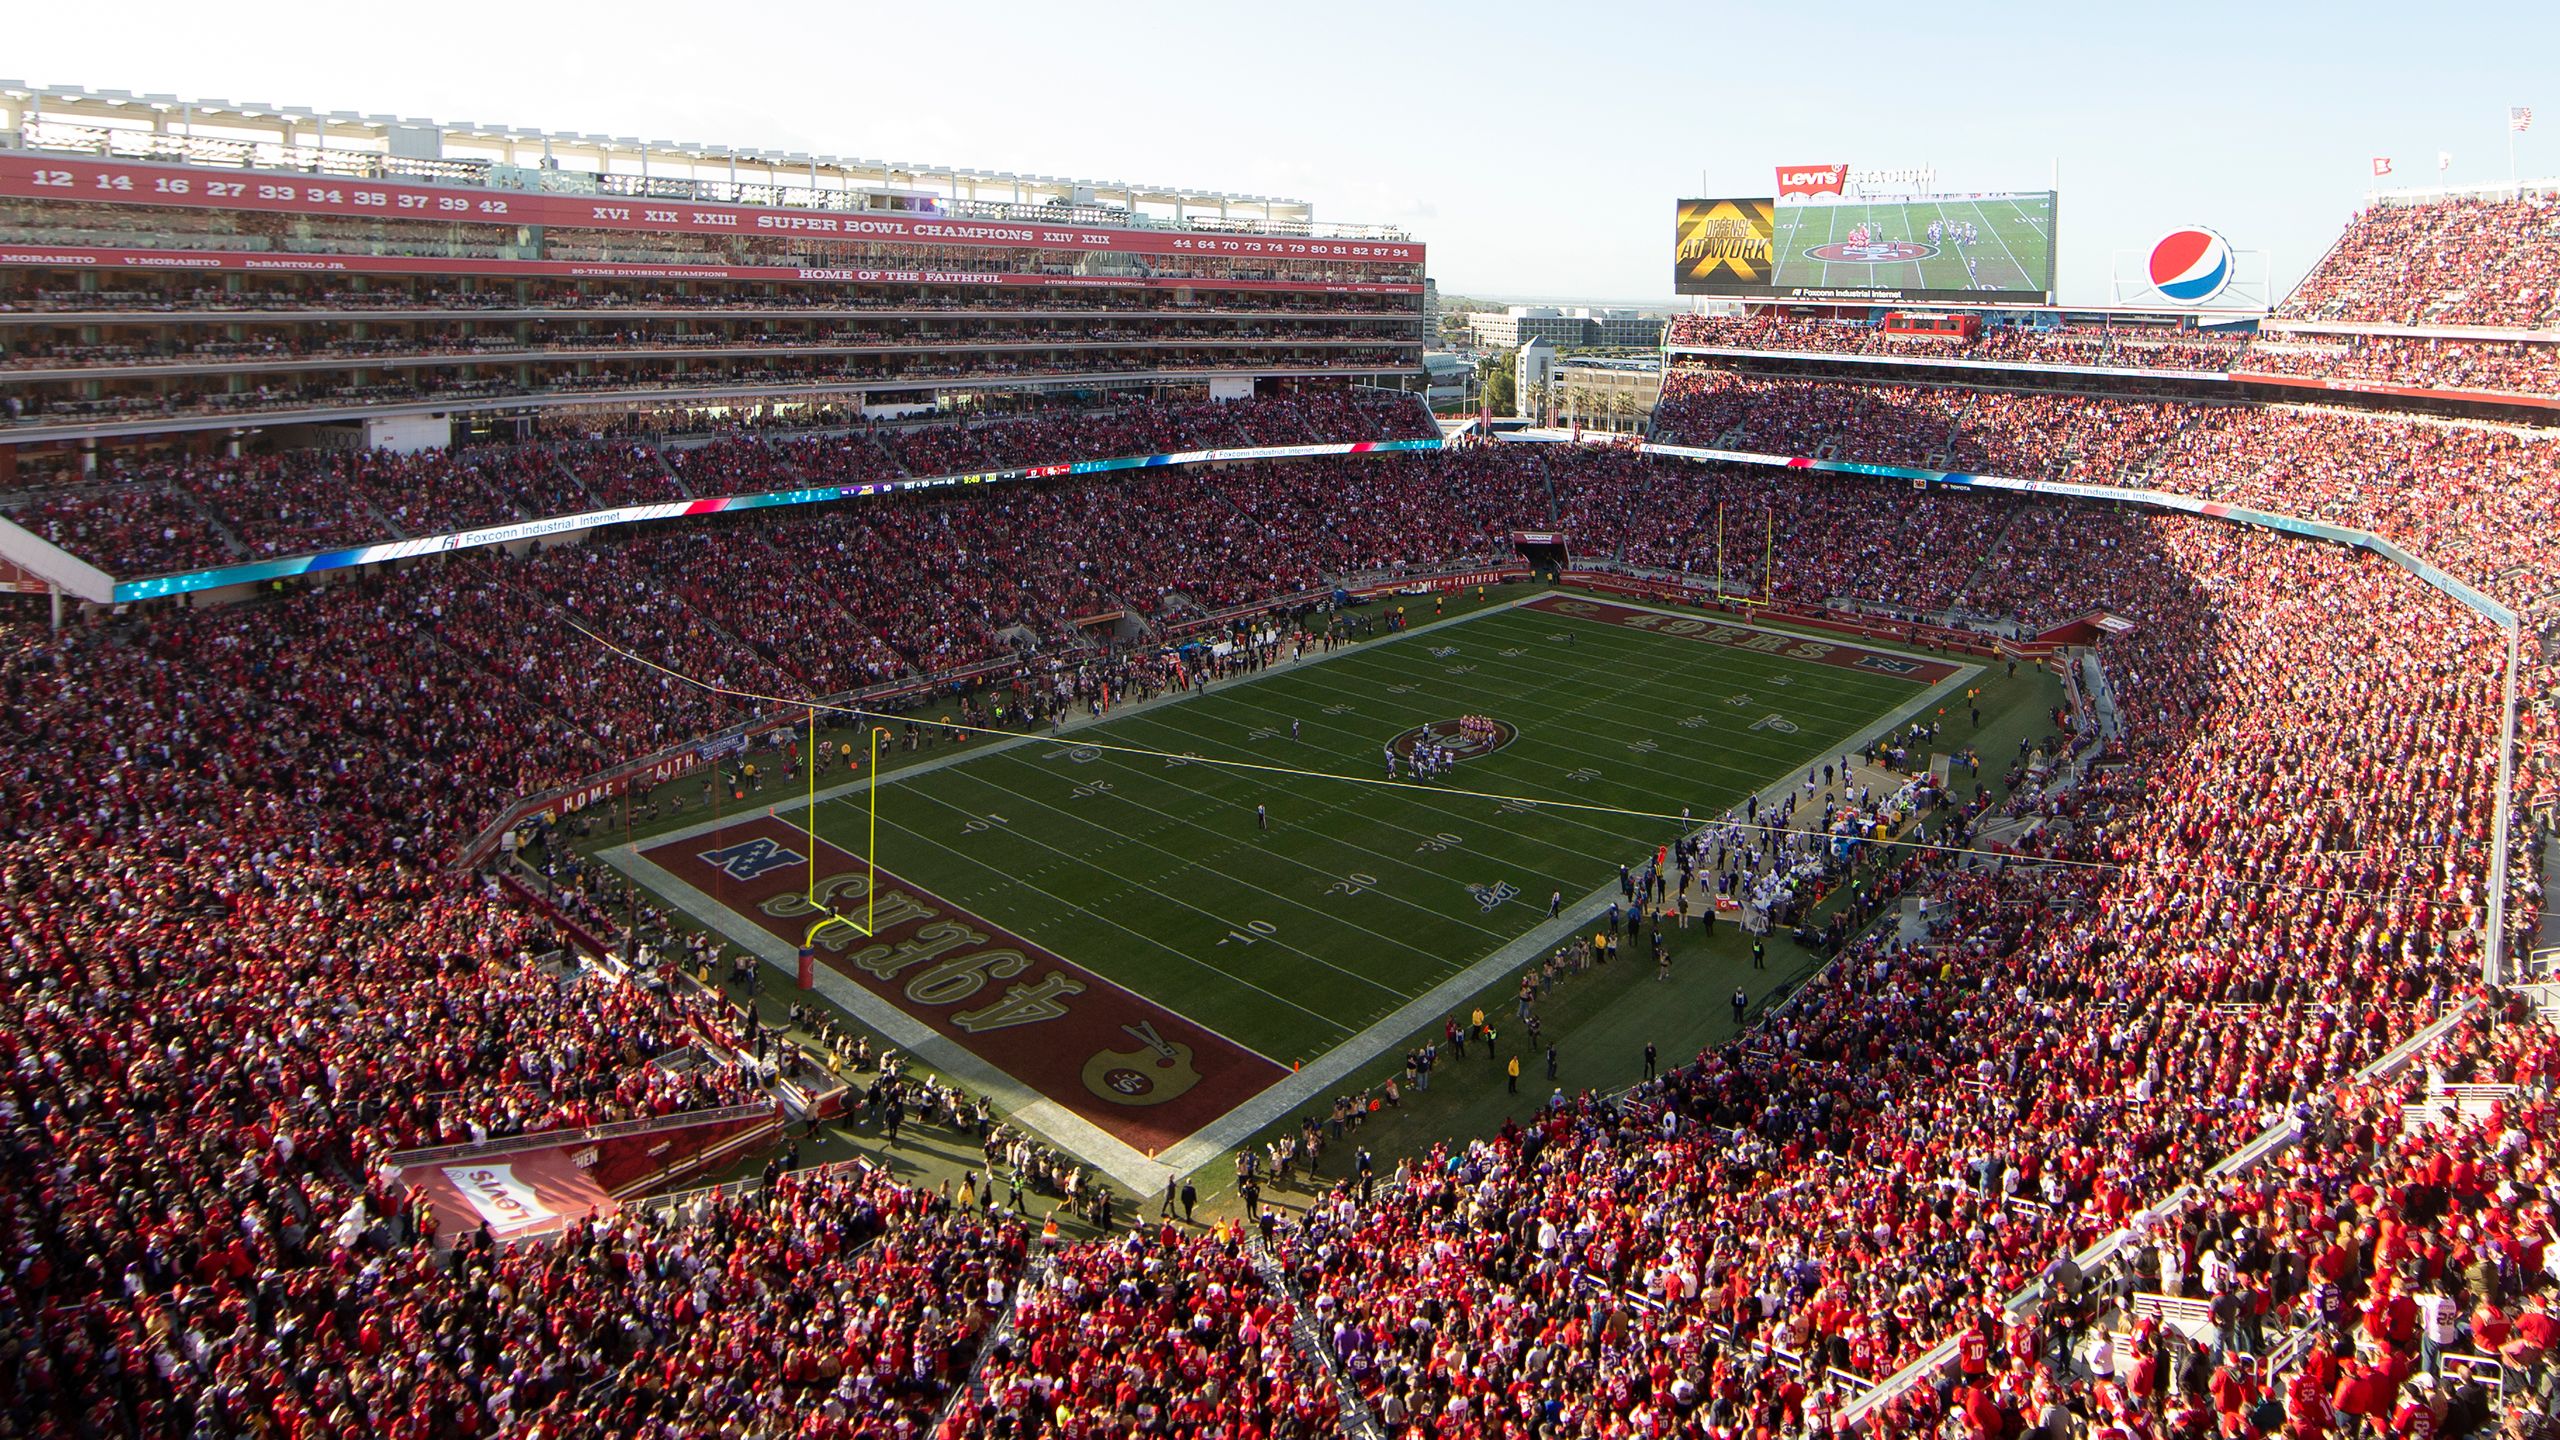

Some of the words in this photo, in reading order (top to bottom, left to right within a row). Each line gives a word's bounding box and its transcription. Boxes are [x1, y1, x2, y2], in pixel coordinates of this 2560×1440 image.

[1846, 168, 1936, 184] STADIUM
[32, 170, 73, 187] 12
[96, 174, 133, 190] 14
[155, 178, 190, 194] 16
[207, 181, 246, 197] 27
[259, 185, 295, 201] 33
[308, 188, 343, 204] 34
[354, 191, 387, 206] 35
[398, 195, 429, 209] 37
[439, 198, 470, 212] 39
[479, 200, 507, 214] 42
[593, 207, 630, 221] XVI
[644, 210, 678, 223] XIX
[693, 212, 737, 225] XXIII
[757, 215, 841, 232] SUPER
[844, 220, 908, 236] BOWL
[913, 224, 1033, 241] CHAMPIONS
[1705, 219, 1751, 237] OFFENSE
[1043, 232, 1073, 243] XXIV
[1081, 234, 1110, 244] XXIX
[1173, 238, 1192, 248] 44
[1197, 240, 1216, 249] 64
[1222, 241, 1240, 250] 70
[1244, 242, 1262, 251] 73
[1267, 243, 1284, 252] 74
[1289, 243, 1306, 253] 79
[1310, 245, 1327, 254] 80
[1333, 246, 1347, 255] 81
[1353, 246, 1369, 256] 82
[1373, 247, 1389, 256] 87
[1393, 248, 1409, 257] 94
[1681, 238, 1706, 258] AT
[1710, 238, 1771, 258] WORK
[2, 254, 96, 264] MORABITO
[141, 258, 221, 267] MORABITO
[799, 269, 852, 280] HOME
[858, 271, 881, 281] OF
[885, 271, 919, 282] THE
[925, 272, 1003, 283] FAITHFUL
[1803, 289, 1834, 297] Foxconn
[1836, 289, 1870, 298] Industrial
[1220, 450, 1250, 458] Foxconn
[1289, 447, 1315, 455] Internet
[963, 475, 980, 484] 9:49
[2041, 483, 2081, 494] Foxconn
[2084, 487, 2128, 499] Industrial
[2133, 491, 2164, 503] Internet
[466, 530, 517, 545] Foxconn
[522, 518, 574, 536] Industrial
[580, 512, 620, 526] Internet
[1455, 573, 1499, 586] FAITHFUL
[1425, 832, 1463, 853] 30
[1332, 872, 1378, 897] 20
[1228, 919, 1278, 947] 10
[755, 872, 1088, 1034] 49ERS
[2484, 1170, 2496, 1182] 85
[1857, 1345, 1870, 1358] 94
[1971, 1343, 1983, 1360] 10
[2302, 1389, 2315, 1402] 52
